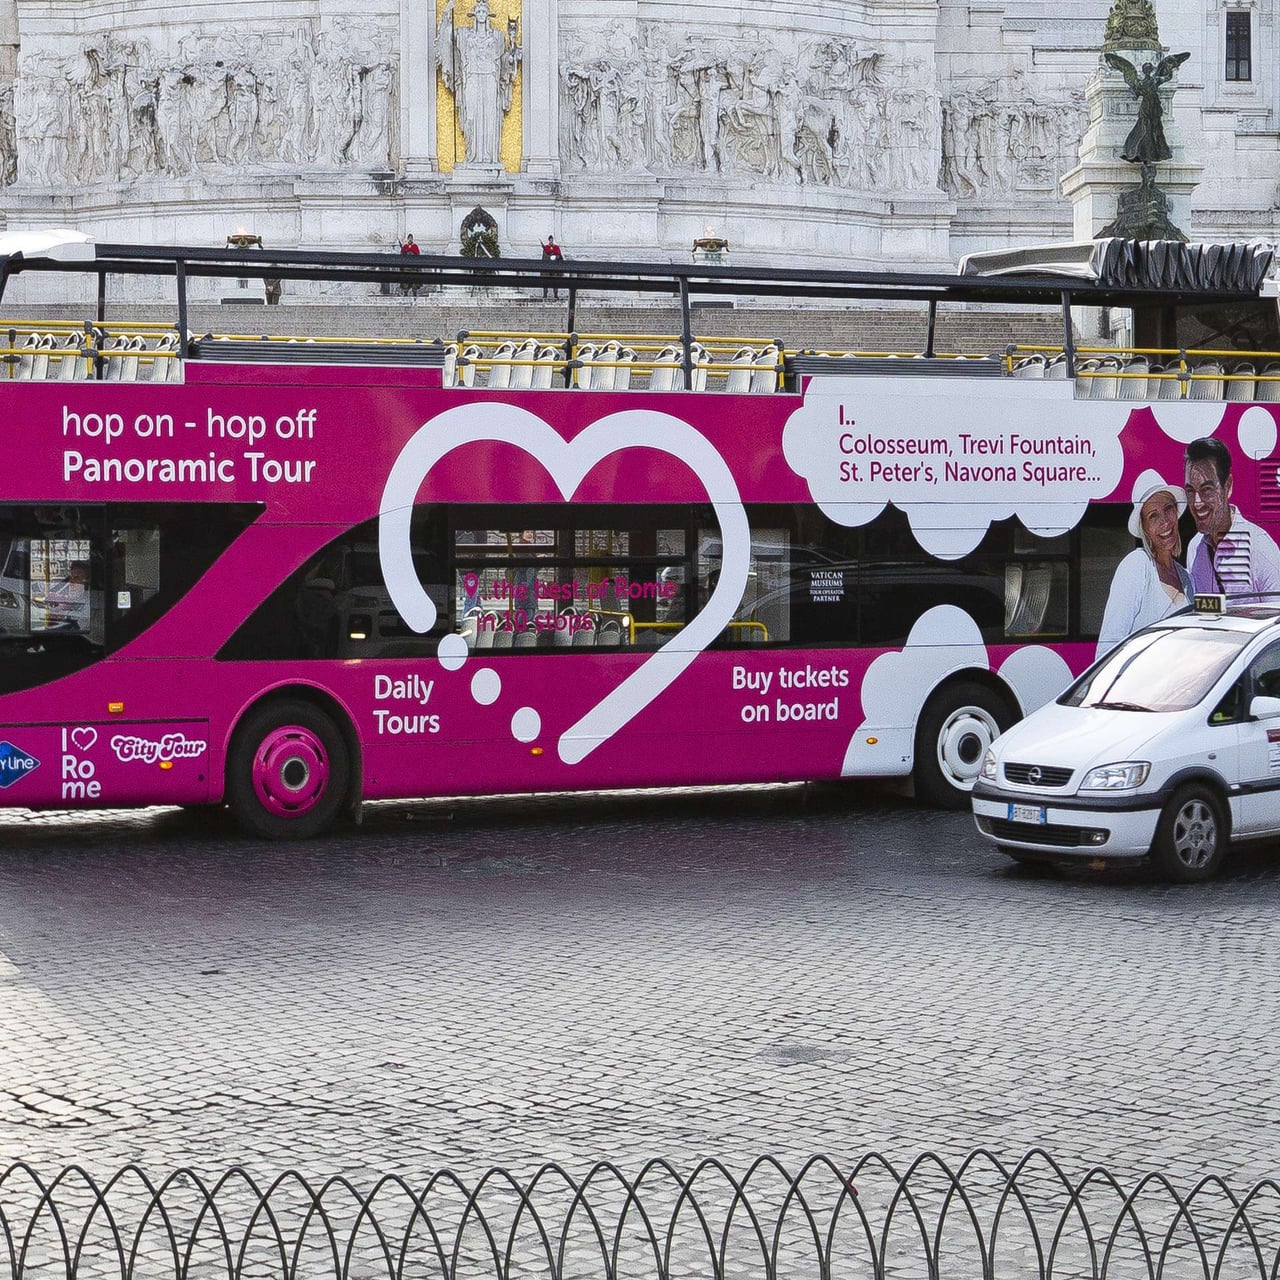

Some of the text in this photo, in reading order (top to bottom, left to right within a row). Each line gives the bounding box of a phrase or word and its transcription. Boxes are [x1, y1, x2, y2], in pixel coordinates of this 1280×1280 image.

[62, 405, 124, 445] hop
[134, 414, 174, 438] on
[207, 407, 267, 446] hop
[275, 408, 317, 439] off
[839, 433, 1097, 458] Colosseum, Trevi Fountain,
[63, 450, 317, 483] Panoramic Tour
[839, 461, 1101, 487] St. Peter's, Navona Square...
[810, 571, 844, 579] VATICAN
[534, 577, 578, 601] best
[586, 576, 609, 600] of
[614, 576, 677, 600] Rome
[1194, 598, 1219, 610] TAXI
[477, 609, 593, 636] in 10 stops
[374, 674, 435, 705] Daily
[732, 664, 849, 695] Buy tickets
[372, 709, 441, 735] Tours
[740, 696, 839, 723] on board
[110, 732, 207, 764] City Tour
[61, 754, 96, 780] Ro
[61, 780, 102, 800] me
